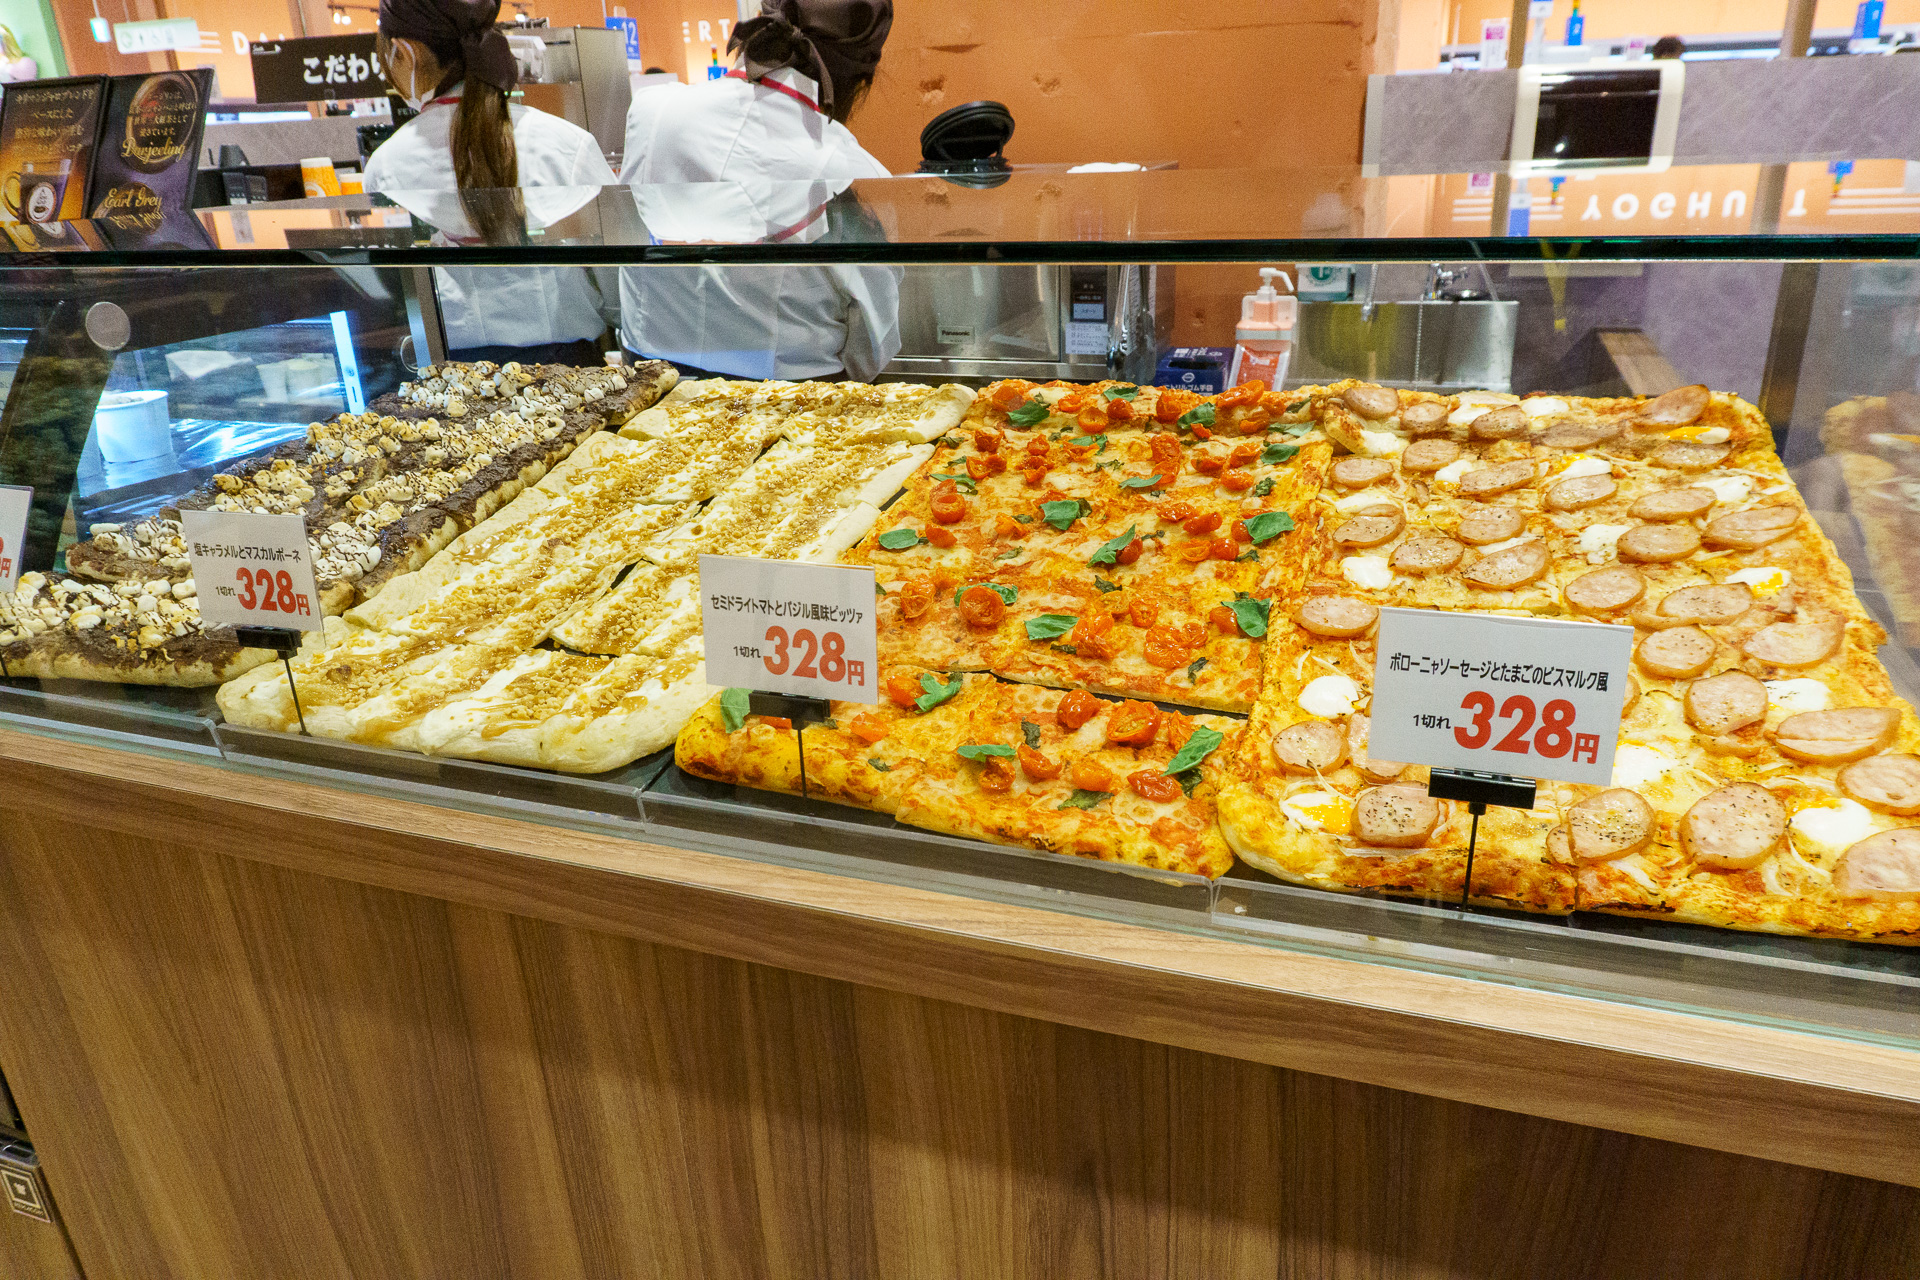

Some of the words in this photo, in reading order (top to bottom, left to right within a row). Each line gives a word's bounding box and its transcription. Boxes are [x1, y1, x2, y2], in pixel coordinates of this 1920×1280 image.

[622, 21, 637, 45] 12
[121, 136, 186, 164] Darjeeling
[104, 187, 134, 208] Earl
[135, 186, 162, 214] Grey
[0, 536, 12, 578] 円
[215, 586, 236, 597] 1切れ
[236, 567, 311, 616] 328円
[711, 594, 863, 624] セミドライトマトとバジル風味ピッツァ
[733, 646, 762, 659] 1切れ
[763, 625, 865, 687] 328円
[1389, 652, 1609, 692] ボローニャソーセージとたまごのビスマルク風
[1413, 714, 1451, 729] 1切れ
[1454, 691, 1600, 764] 328円
